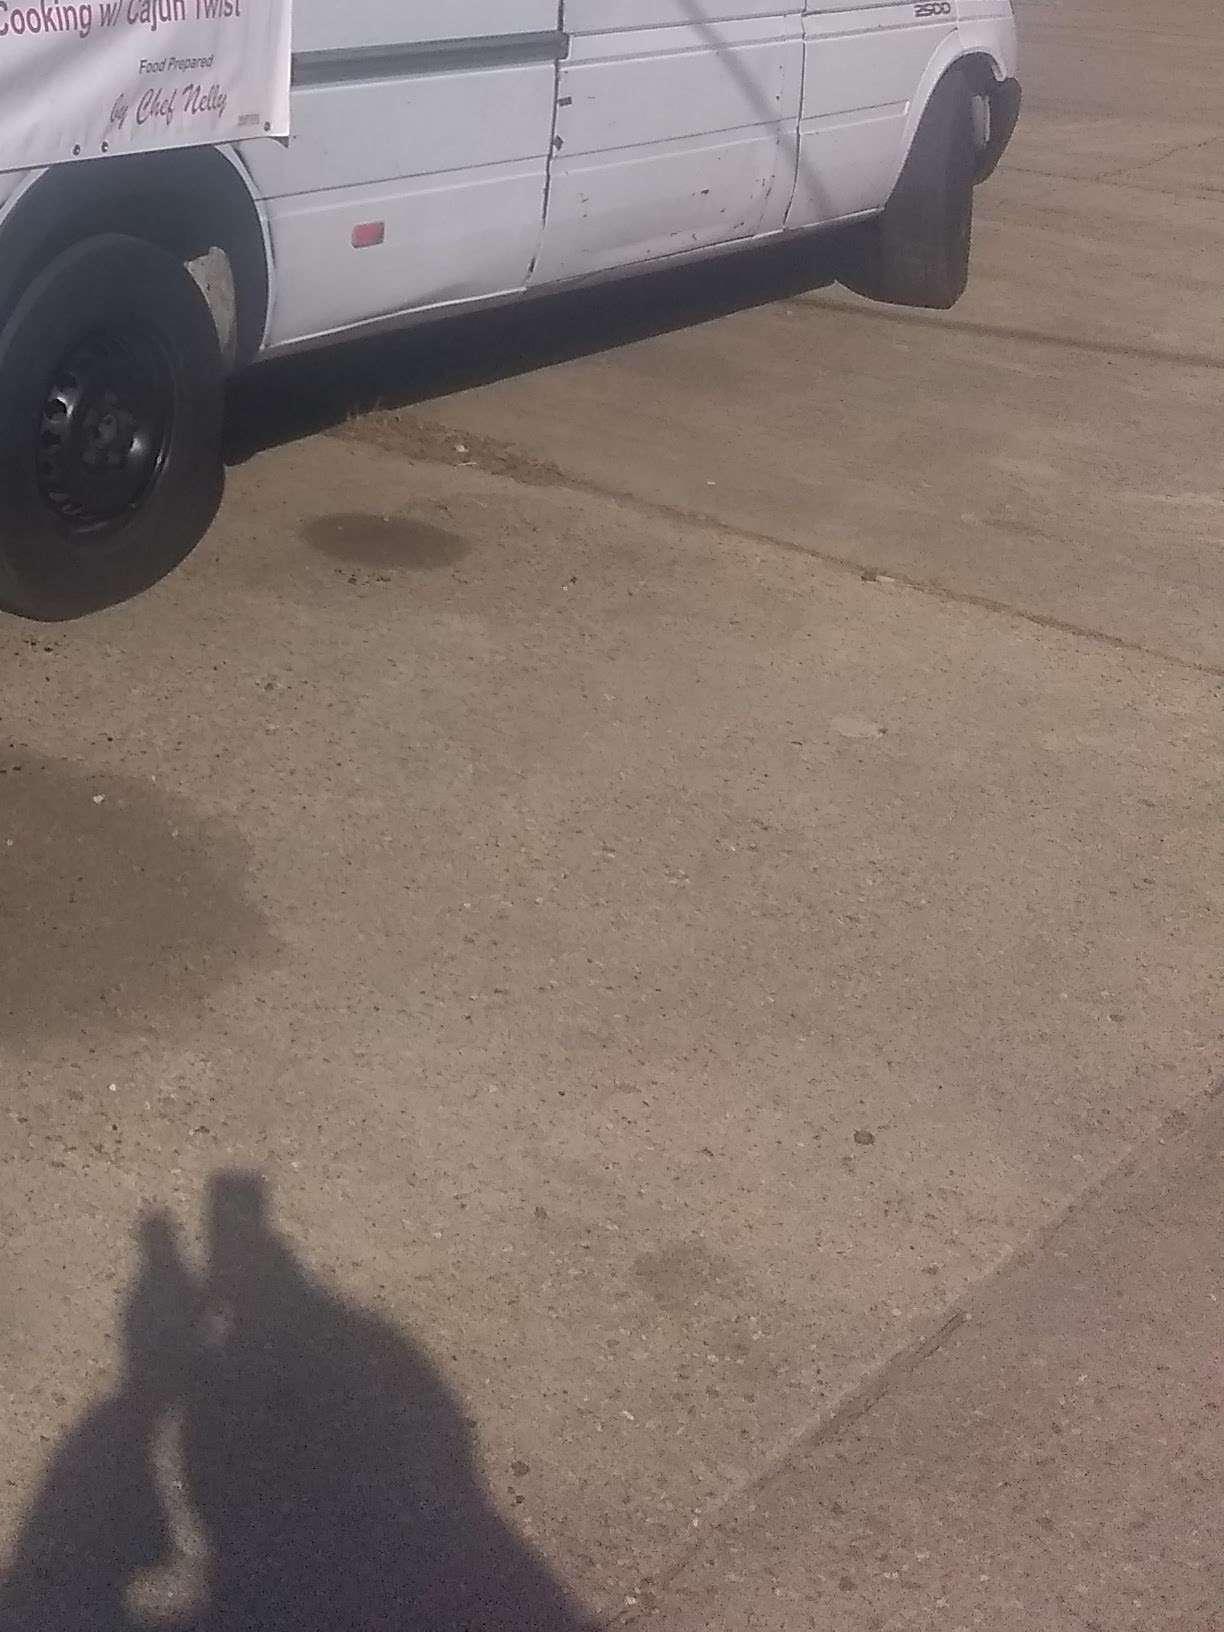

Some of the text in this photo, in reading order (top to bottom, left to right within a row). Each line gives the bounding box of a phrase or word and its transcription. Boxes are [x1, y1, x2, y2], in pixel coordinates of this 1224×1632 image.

[914, 1, 951, 18] 2500
[138, 53, 214, 75] Food Prepared
[109, 82, 228, 130] by Chef Nelly
